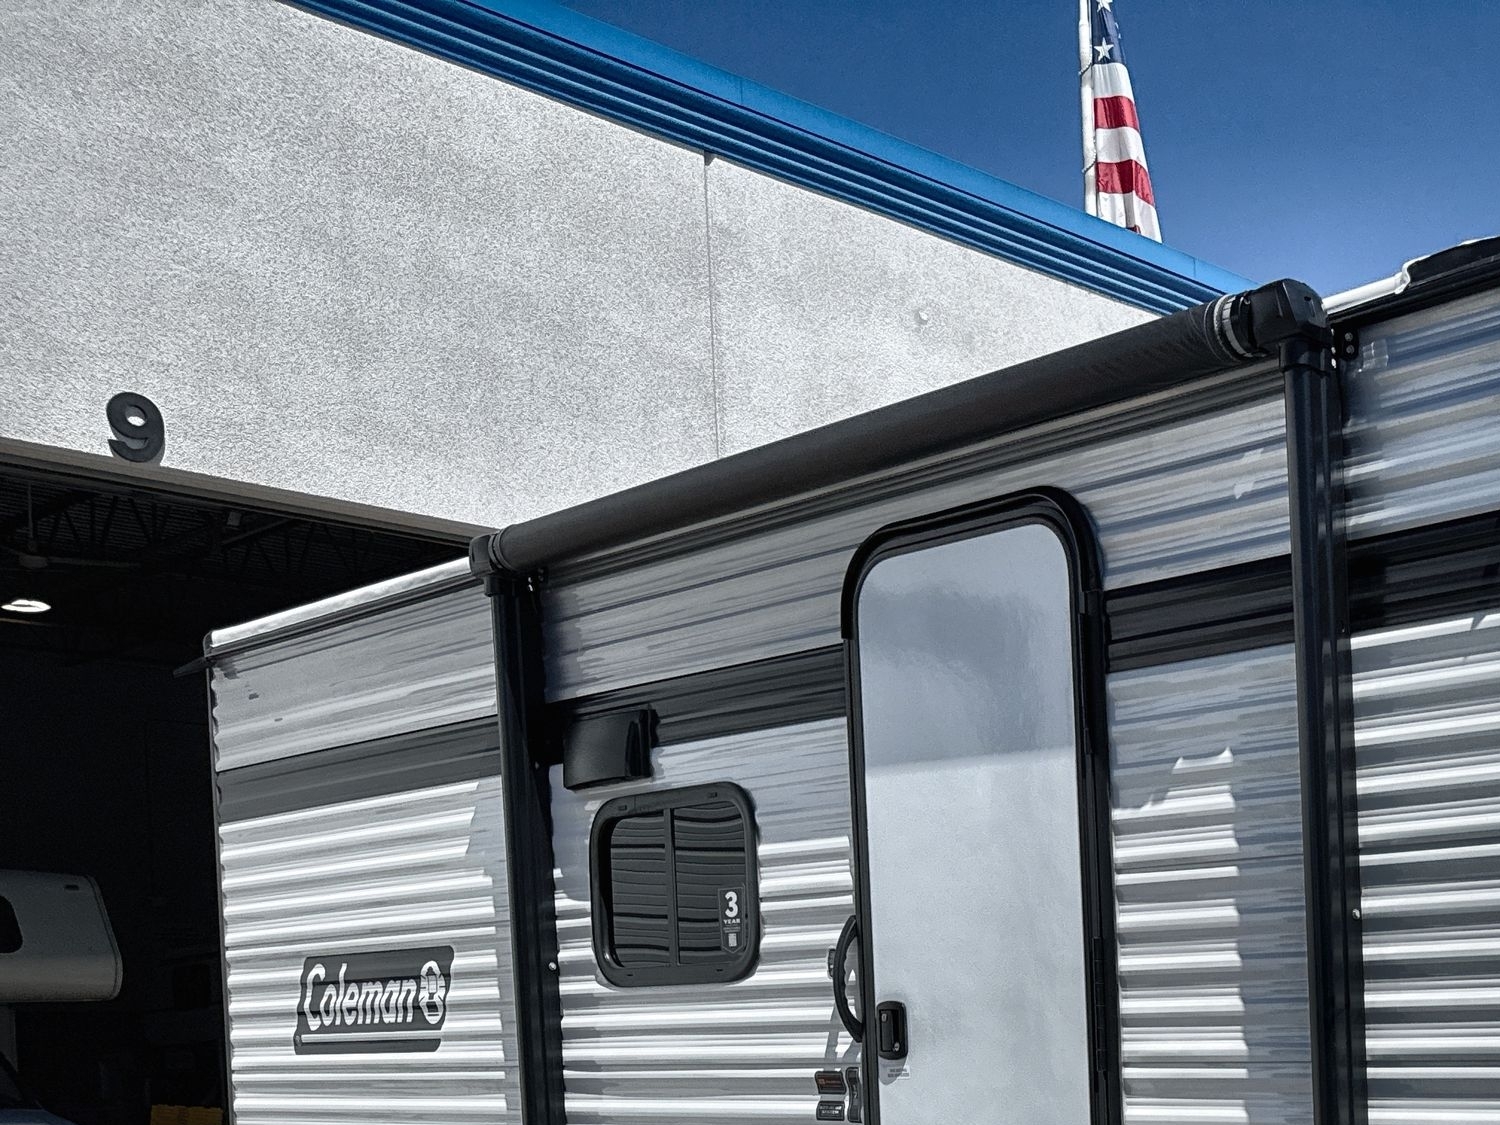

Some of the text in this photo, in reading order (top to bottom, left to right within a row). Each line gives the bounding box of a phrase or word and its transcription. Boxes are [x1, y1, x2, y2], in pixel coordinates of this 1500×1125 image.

[106, 392, 165, 463] 9
[725, 891, 739, 918] 3
[304, 962, 417, 1031] Coleman
